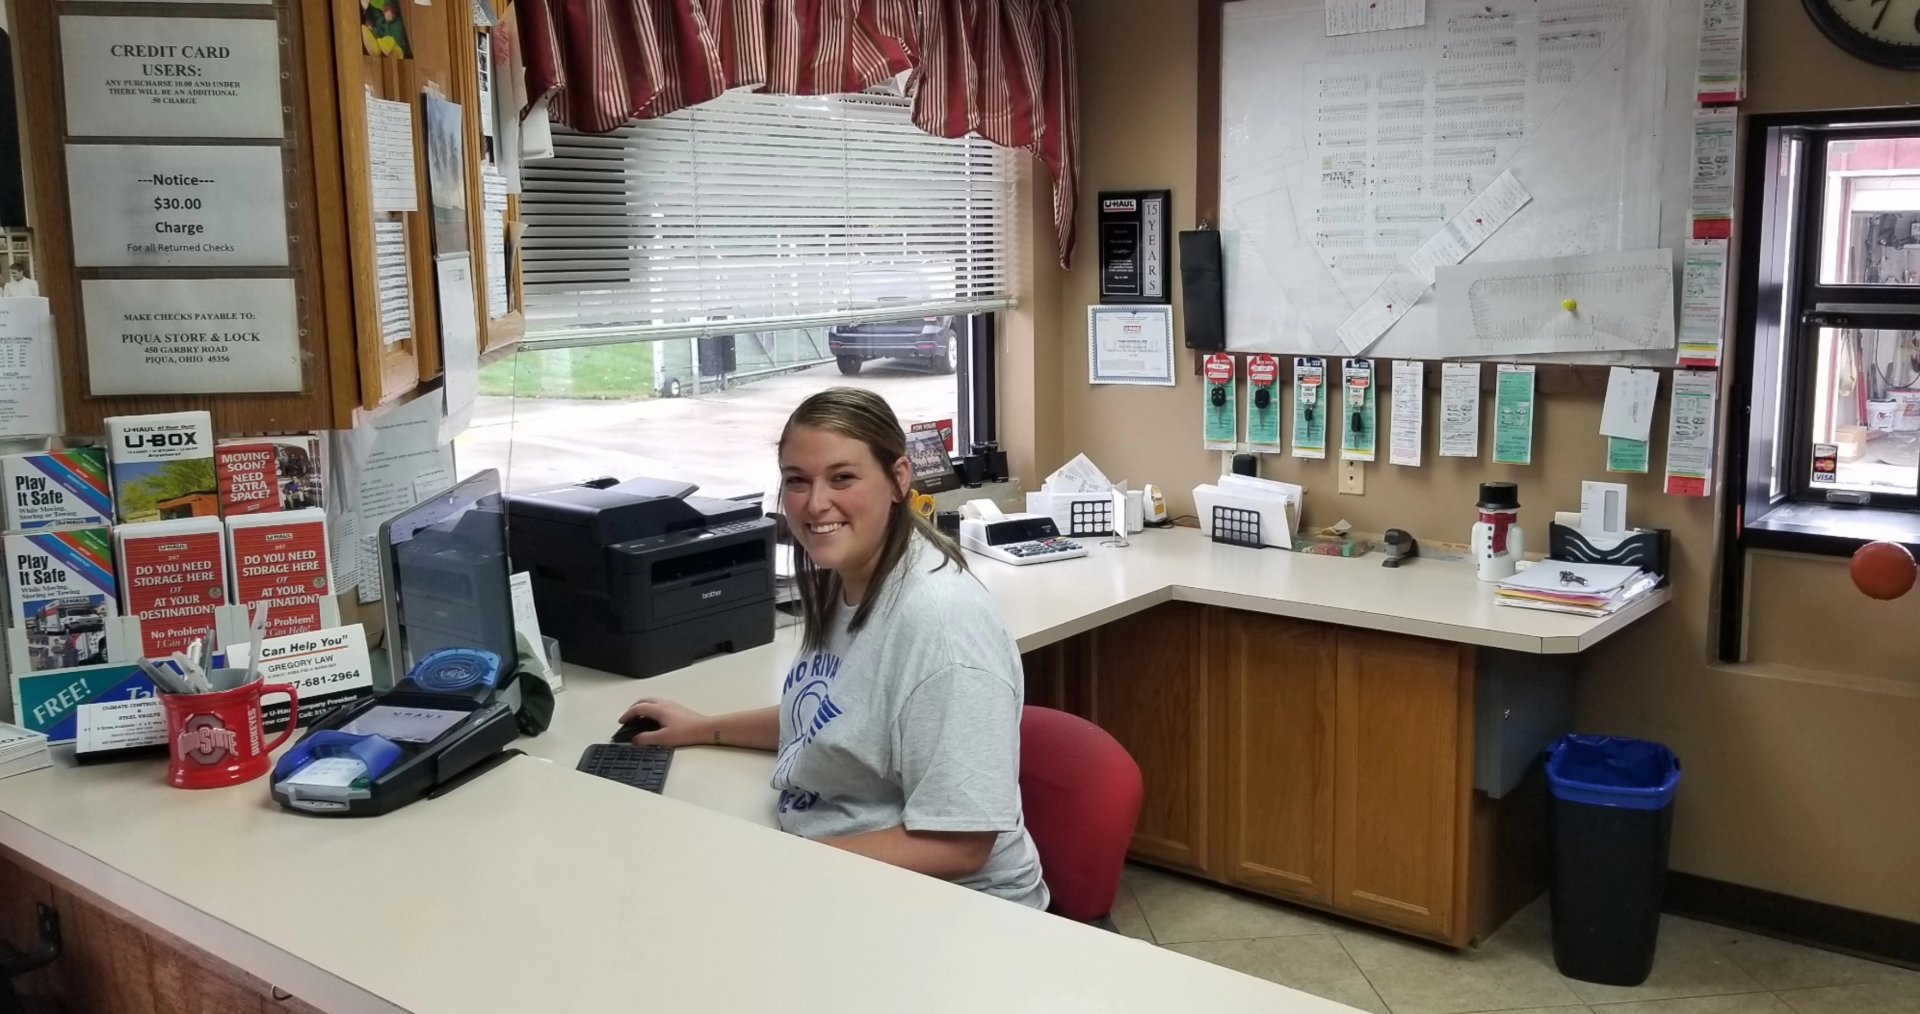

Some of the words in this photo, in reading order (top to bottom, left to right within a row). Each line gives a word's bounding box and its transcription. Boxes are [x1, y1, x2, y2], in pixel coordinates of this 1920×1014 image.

[110, 44, 177, 58] CREDIT
[181, 45, 230, 59] CARD
[142, 63, 202, 77] USERS:
[187, 89, 238, 97] ADDITIONAL
[153, 196, 202, 211] $30.00
[1104, 200, 1135, 208] U-HAUL
[1147, 204, 1158, 216] 15
[155, 221, 205, 236] Charge
[126, 243, 142, 252] For
[145, 243, 156, 252] all
[158, 243, 201, 252] Returned
[202, 243, 236, 252] Checks
[123, 313, 152, 321] MAKE
[153, 313, 193, 321] CHECKS
[194, 312, 238, 321] PAYABLE
[238, 312, 256, 320] TO:
[121, 333, 162, 345] PIQUA
[164, 332, 208, 343] STORE
[210, 332, 221, 342] &
[223, 332, 261, 342] LOCK
[160, 345, 200, 354] GARBRY
[201, 345, 229, 353] ROAD
[145, 355, 177, 365] PIQUA,
[178, 355, 204, 363] OHIO
[207, 355, 231, 363] 45356
[124, 431, 198, 449] U-BOX
[221, 451, 270, 463] MOVING
[227, 460, 266, 473] SOON?
[15, 475, 46, 492] Play
[232, 472, 264, 483] NEED
[1816, 473, 1835, 481] VISA
[231, 480, 268, 493] EXTRA
[17, 492, 29, 507] It
[31, 490, 64, 506] Safe
[230, 489, 271, 502] SPACE?
[19, 512, 44, 520] Storing
[17, 554, 49, 571] Play
[244, 555, 261, 566] DO
[263, 553, 286, 564] YOU
[288, 550, 317, 561] NEED
[135, 565, 154, 576] DO
[156, 563, 180, 575] YOU
[182, 560, 212, 572] NEED
[242, 563, 290, 577] STORAGE
[292, 560, 320, 573] HERE
[19, 571, 32, 586] It
[33, 568, 67, 585] Safe
[134, 573, 185, 587] STORAGE
[186, 571, 217, 583] HERE
[275, 576, 289, 584] or
[21, 592, 47, 600] Storing
[57, 589, 81, 597] Towing
[169, 586, 183, 594] or
[261, 588, 274, 598] AT
[276, 584, 306, 596] YOUR
[702, 589, 722, 600] brother
[153, 597, 168, 608] AT
[170, 594, 201, 606] YOUR
[247, 593, 320, 611] DTINATION?
[139, 603, 216, 621] DESTINATION?
[273, 614, 315, 627] Problem!
[150, 630, 165, 640] No
[167, 625, 210, 638] Problem!
[269, 627, 288, 637] Can
[162, 638, 181, 649] Can
[261, 646, 286, 658] Can
[290, 641, 318, 654] Help
[267, 658, 313, 673] GREGORY
[314, 654, 335, 665] LAW
[288, 669, 361, 690] 7-681-2964
[782, 660, 808, 696] NO
[32, 677, 92, 725] FREE!
[327, 694, 358, 705] President
